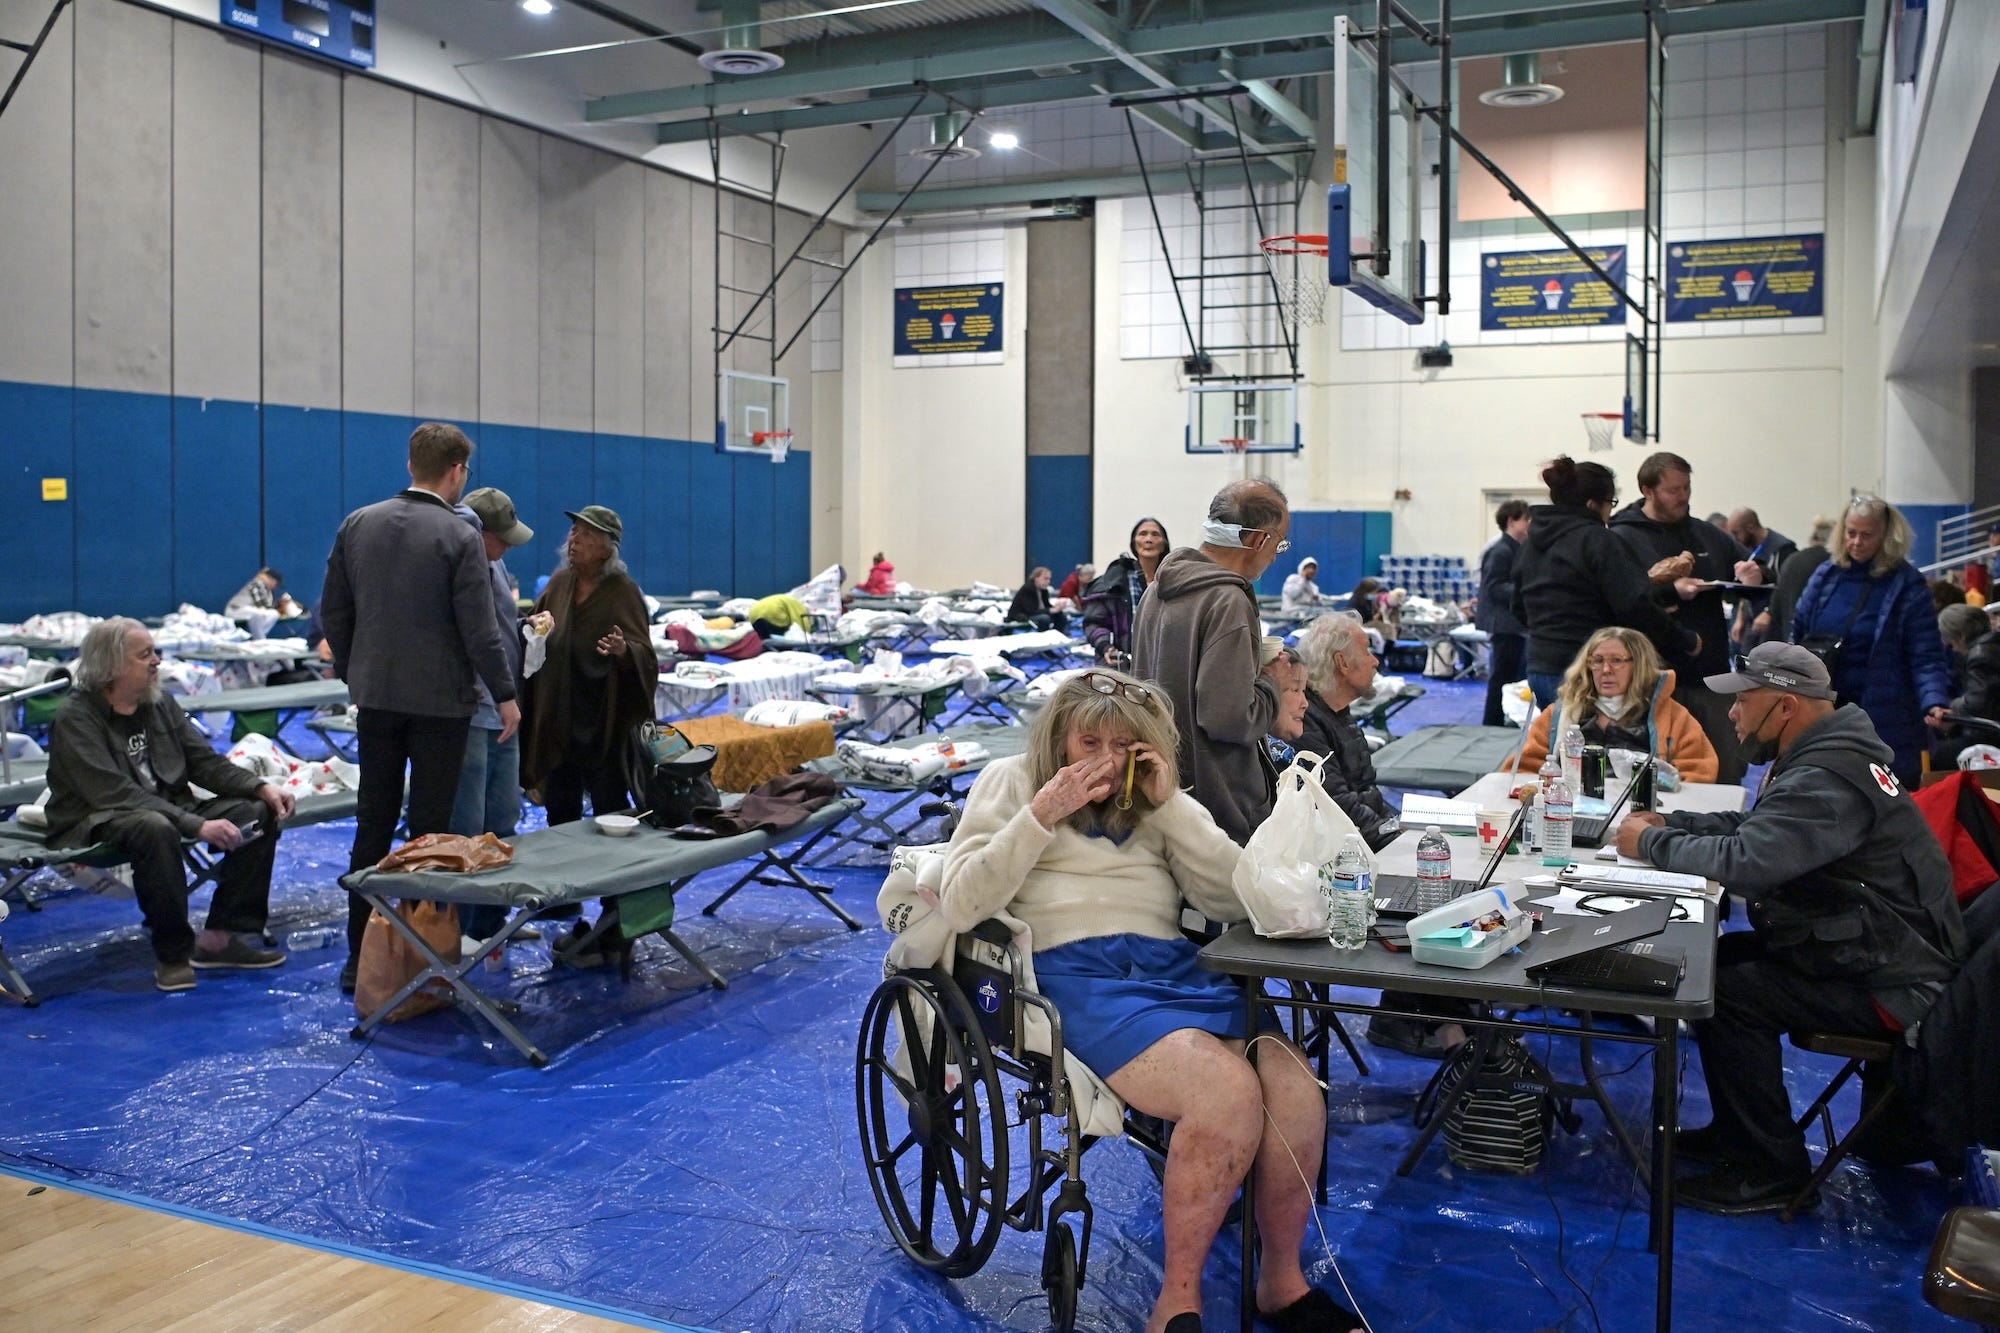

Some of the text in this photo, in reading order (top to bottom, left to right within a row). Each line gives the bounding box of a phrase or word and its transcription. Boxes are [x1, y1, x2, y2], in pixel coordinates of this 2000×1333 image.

[1763, 671, 1797, 685] LOS ANGELES
[979, 987, 998, 998] MEDLINE
